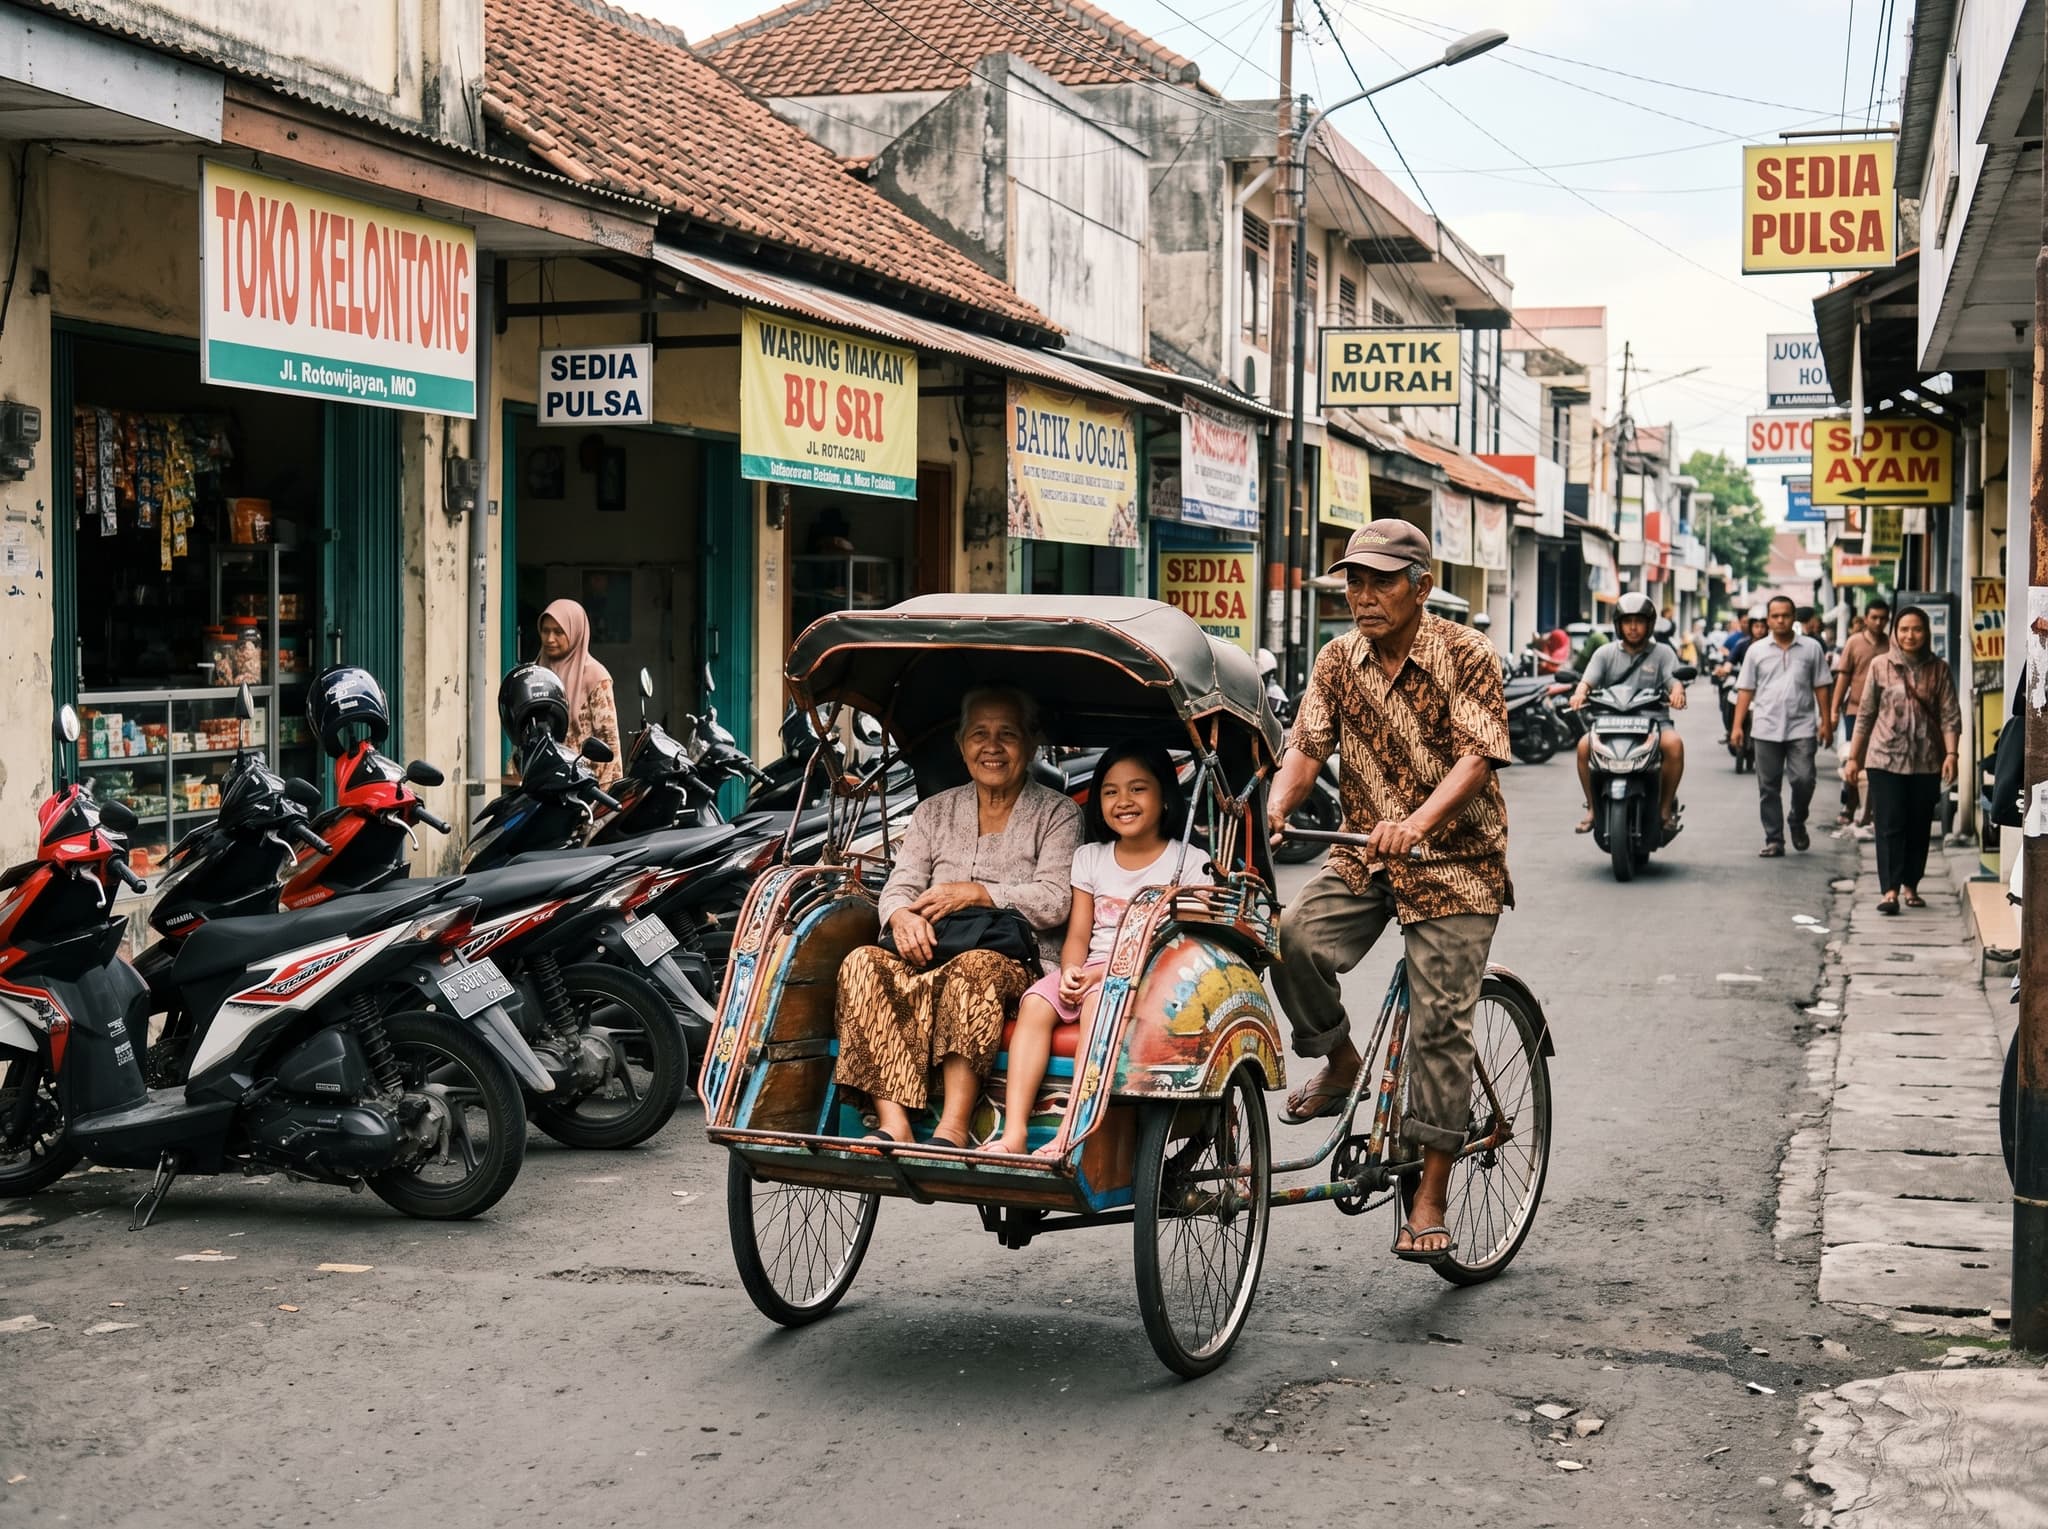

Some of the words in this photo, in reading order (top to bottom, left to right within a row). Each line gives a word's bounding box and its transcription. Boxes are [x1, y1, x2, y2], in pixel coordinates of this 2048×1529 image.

[1757, 153, 1880, 201] SEDIA
[1752, 210, 1885, 255] PULSA
[215, 186, 300, 325] TOKO
[309, 208, 469, 354] KELONTONG
[551, 353, 638, 381] SEDIA
[760, 322, 840, 371] WARUNG
[845, 343, 904, 385] MAKAN
[1343, 342, 1441, 364] BATIK
[280, 359, 297, 381] Jl.
[302, 361, 388, 398] Rotowijayan,
[1331, 370, 1453, 393] MURAH
[547, 390, 642, 417] PULSA
[784, 372, 828, 432] BU
[836, 384, 884, 443] SRI
[1016, 406, 1070, 460] BATIK
[1075, 419, 1129, 471] JOGJA
[1827, 425, 1939, 452] SOTO
[1825, 457, 1941, 483] AYAM
[1166, 558, 1246, 583] SEDIA
[1166, 590, 1247, 619] PULSA
